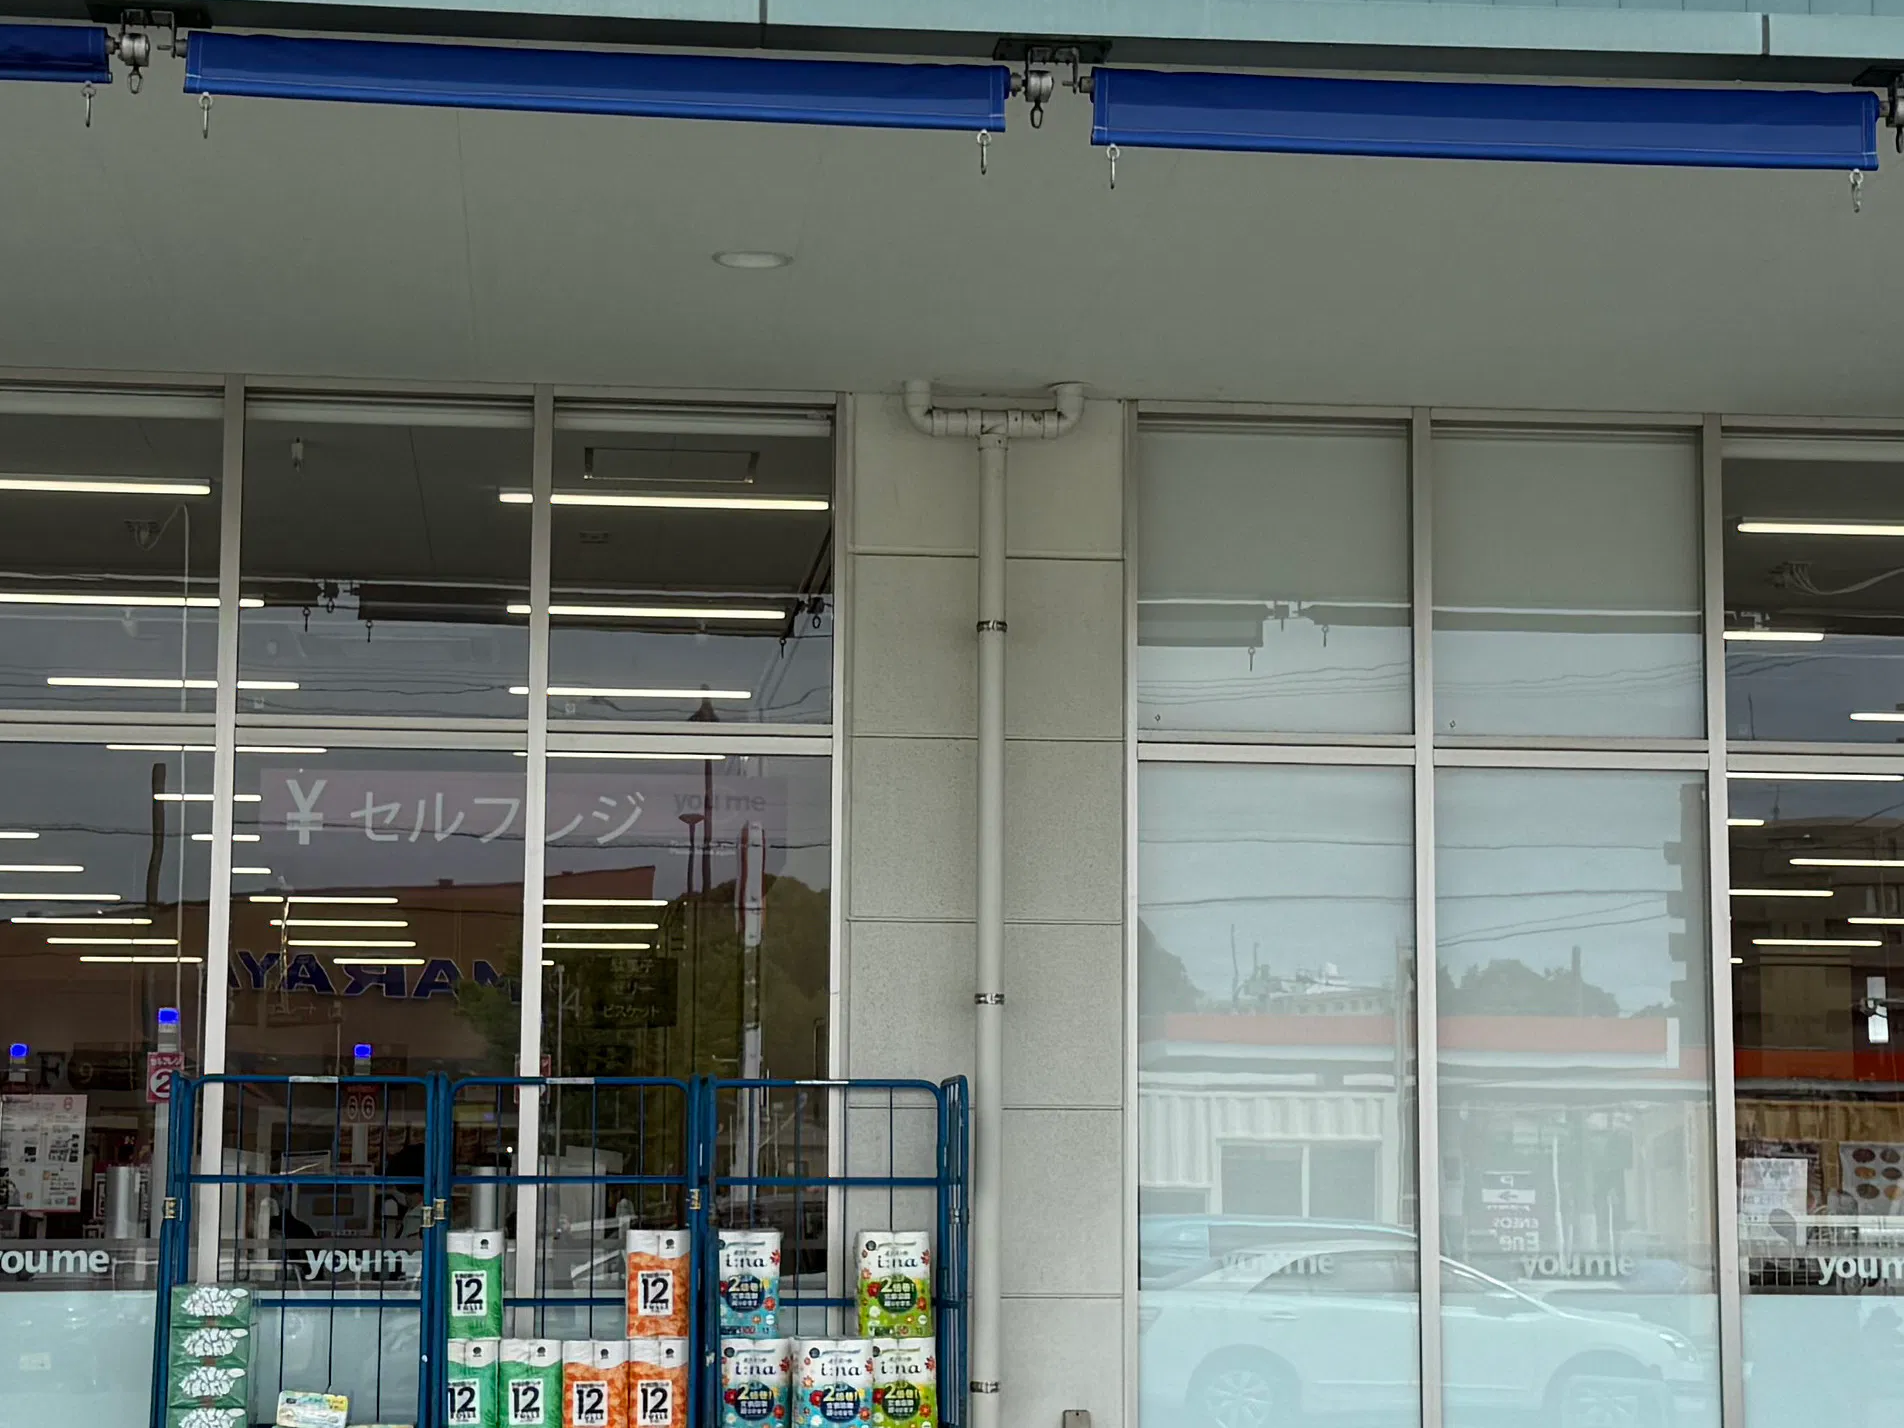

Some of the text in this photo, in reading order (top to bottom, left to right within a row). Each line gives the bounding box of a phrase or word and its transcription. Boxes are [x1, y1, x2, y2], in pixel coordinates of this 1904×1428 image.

[305, 1249, 423, 1280] youm
[456, 1277, 483, 1305] 12
[642, 1277, 669, 1305] 12
[448, 1387, 476, 1414] 12
[512, 1387, 540, 1414] 12
[576, 1388, 604, 1415] 12
[641, 1387, 668, 1415] 12
